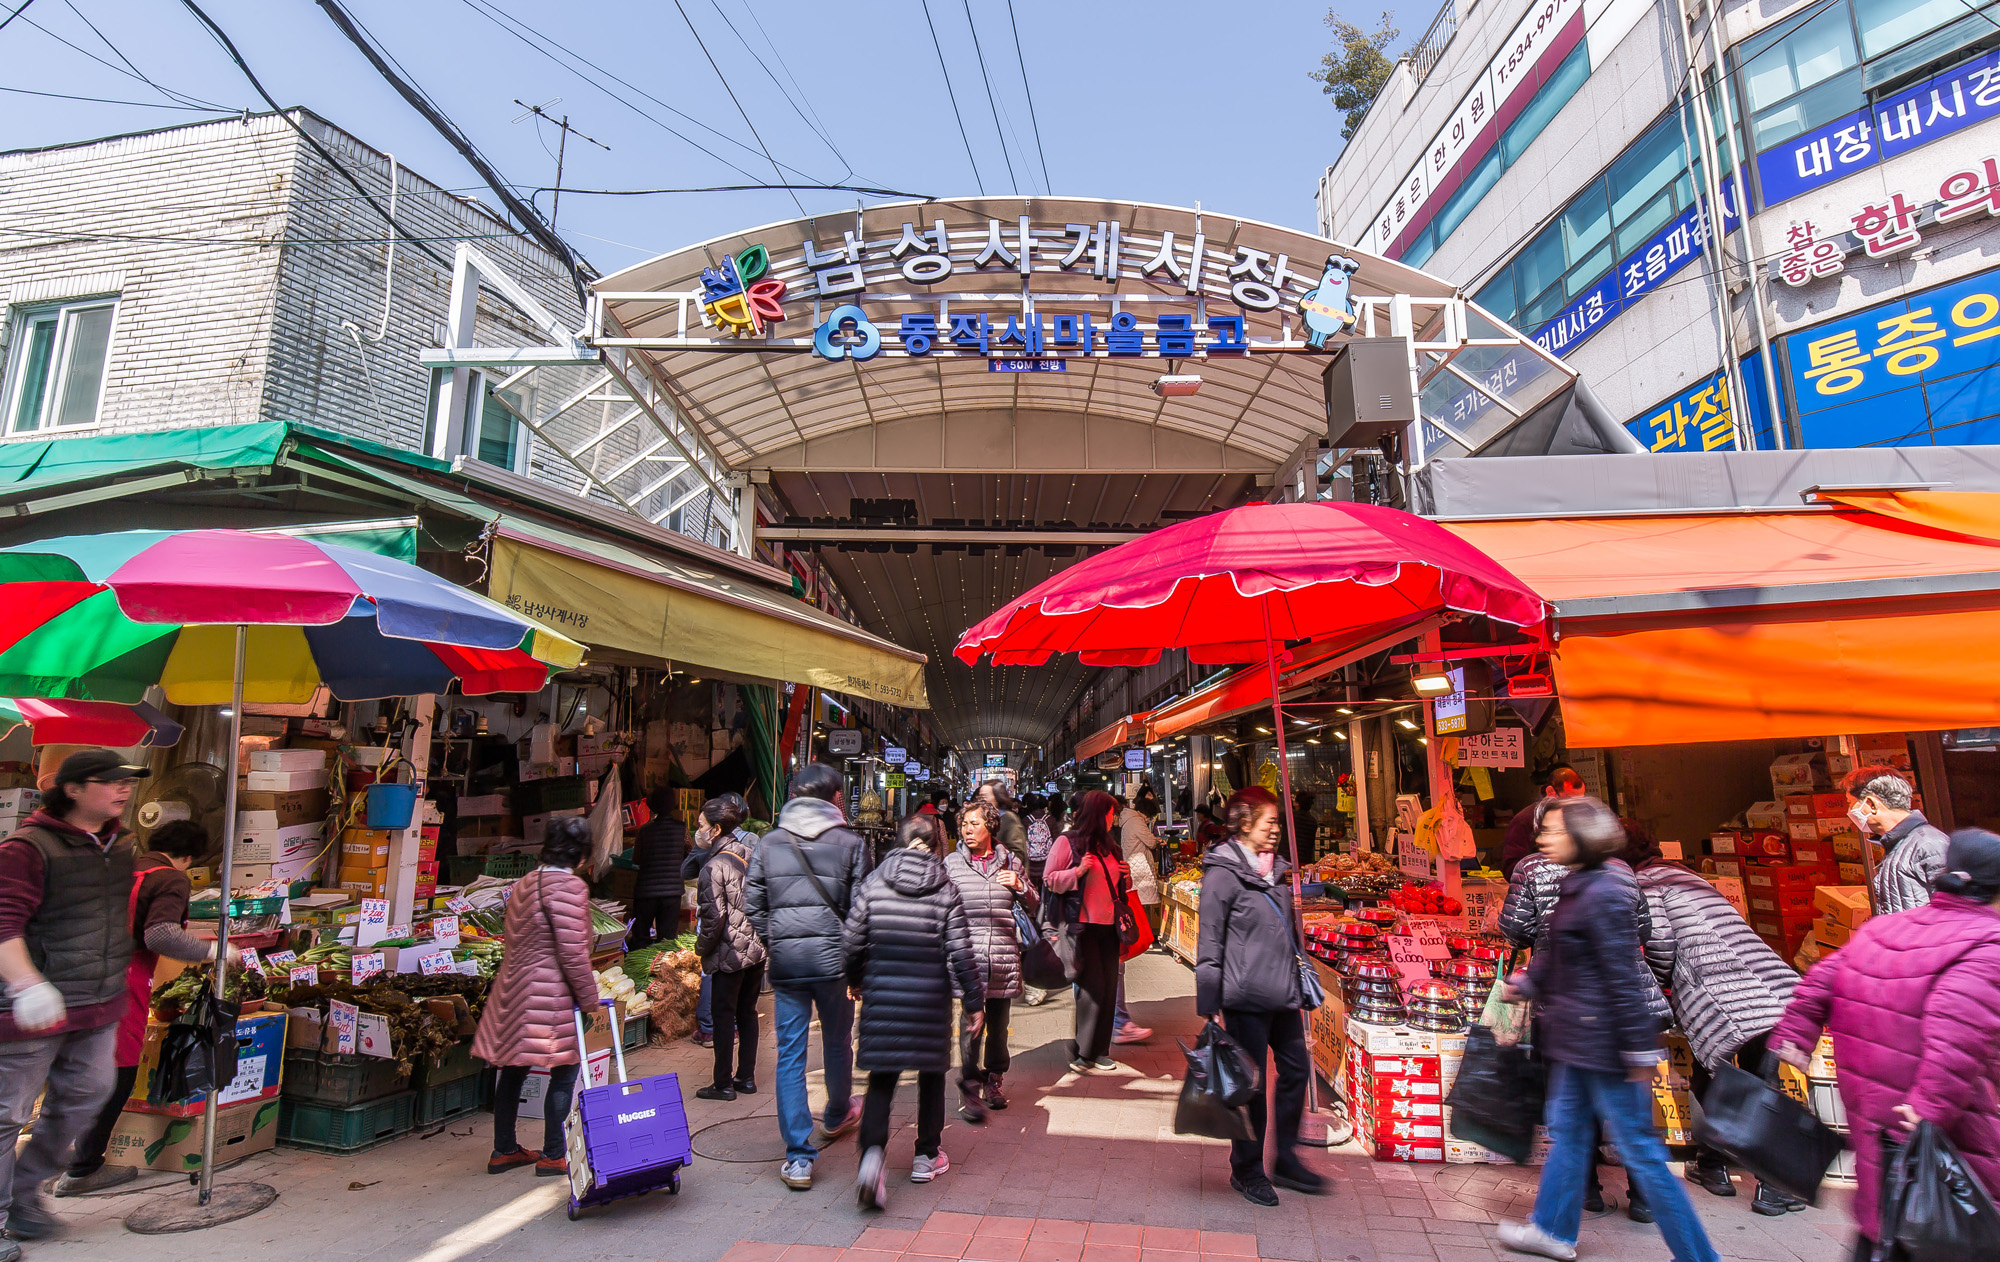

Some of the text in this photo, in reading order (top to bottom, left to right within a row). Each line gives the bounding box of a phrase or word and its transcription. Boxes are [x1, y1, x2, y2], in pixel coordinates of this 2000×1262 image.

[1497, 0, 1567, 84] T.534-997
[1786, 220, 1816, 251] 참
[803, 215, 1293, 312] 남성사계시장
[1781, 243, 1841, 284] 좋은
[898, 311, 1249, 357] 동작새마을금고
[1010, 360, 1060, 370] 50M 전방
[525, 600, 589, 628] 남성사계시장
[1438, 717, 1464, 731] 533-5870
[1471, 751, 1518, 760] 포인트적립
[1466, 893, 1486, 904] 각종
[618, 1108, 656, 1124] HUGGIES
